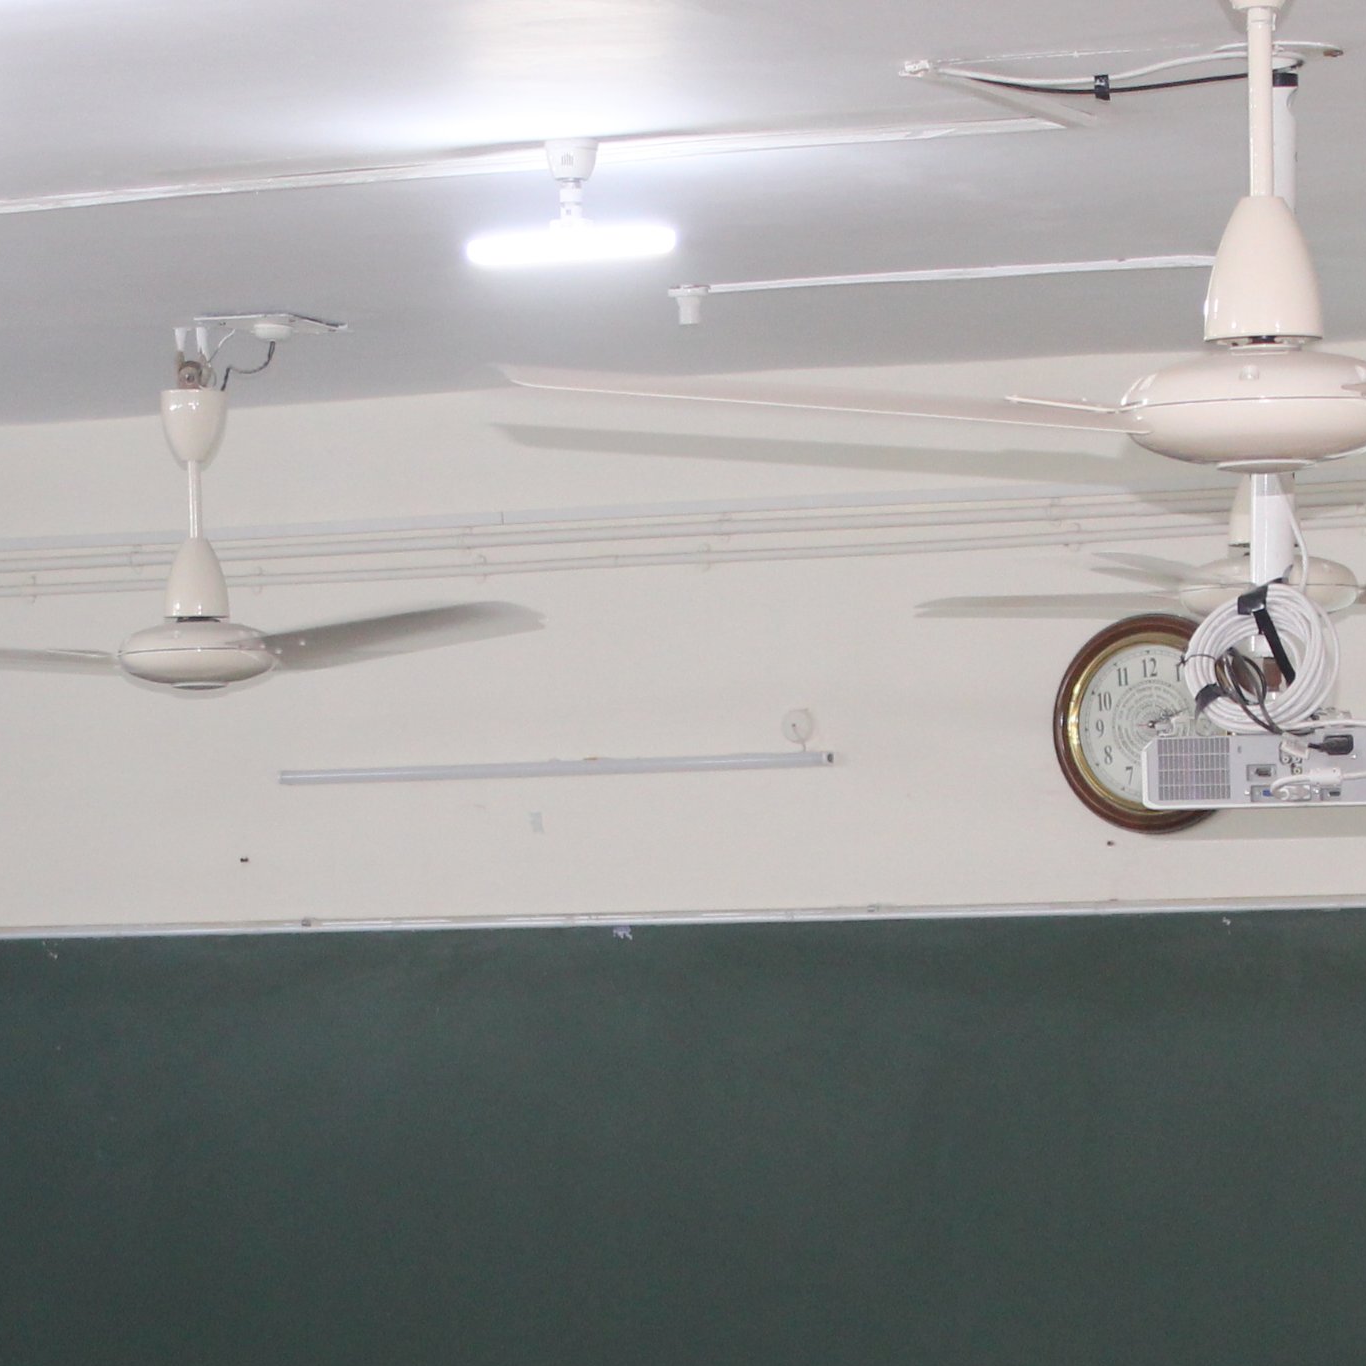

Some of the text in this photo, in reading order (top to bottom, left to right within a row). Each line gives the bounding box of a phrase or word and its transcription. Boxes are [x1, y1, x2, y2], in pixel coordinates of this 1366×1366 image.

[1117, 666, 1129, 687] 11
[1142, 657, 1158, 679] 12
[1097, 691, 1112, 712] 10
[1095, 718, 1104, 738] 9
[1104, 745, 1113, 765] 8
[1125, 766, 1133, 786] 7
